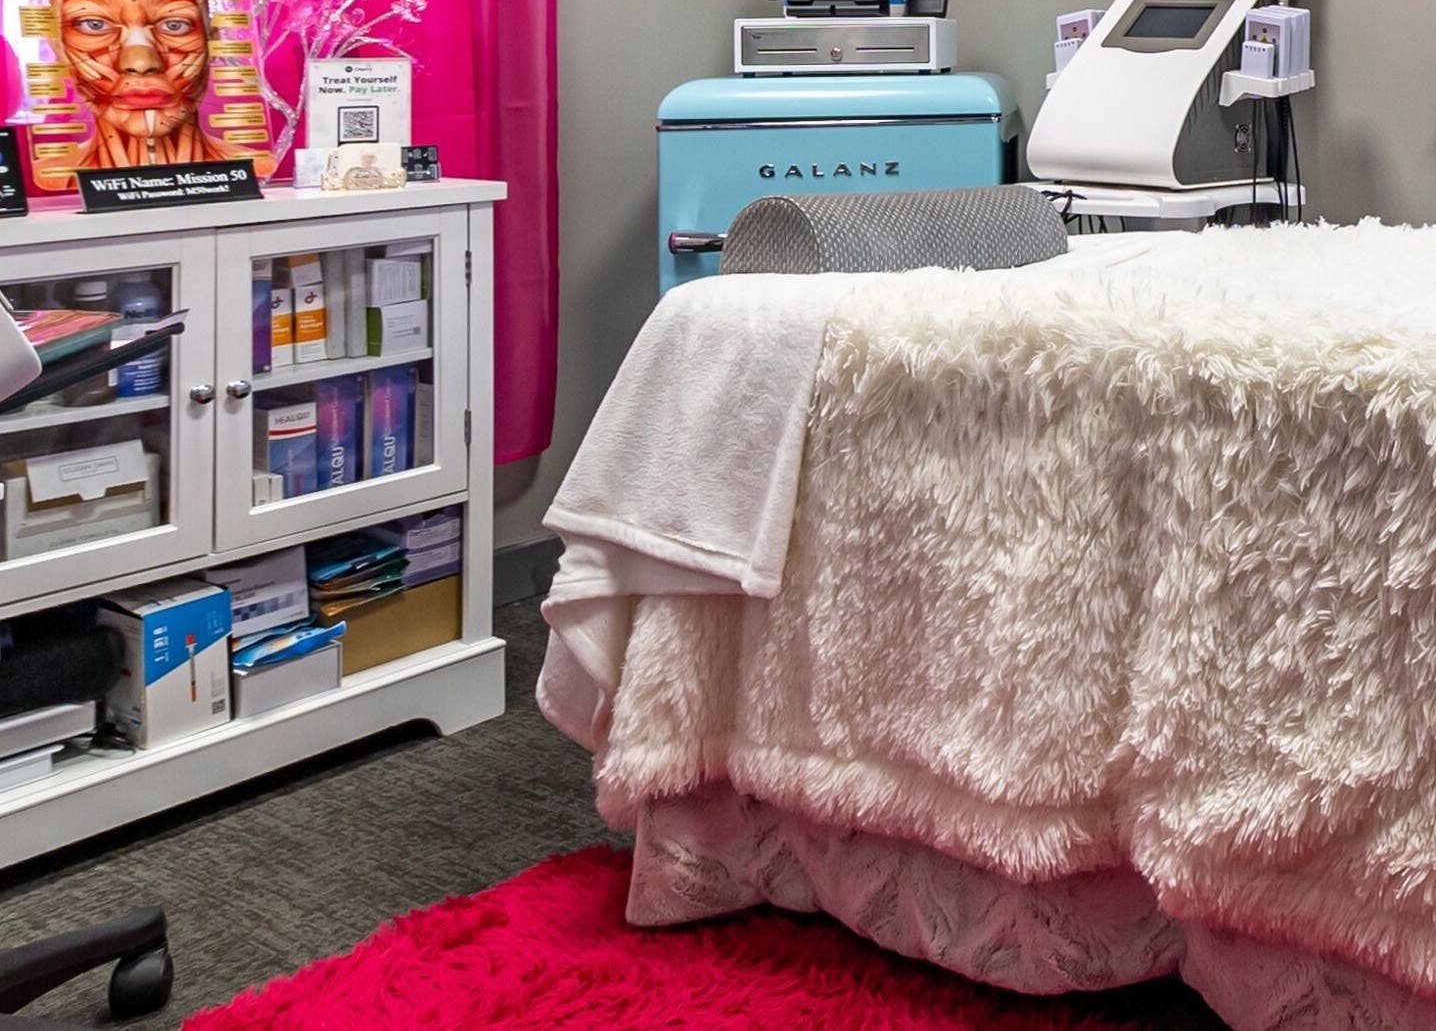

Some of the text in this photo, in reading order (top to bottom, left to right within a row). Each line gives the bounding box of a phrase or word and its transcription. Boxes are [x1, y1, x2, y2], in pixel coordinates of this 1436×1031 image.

[322, 75, 398, 85] Treat Yourself
[318, 85, 400, 95] Now. Pay Later.
[758, 161, 899, 179] GALANZ
[90, 169, 247, 192] WiFi Name: Mission 50
